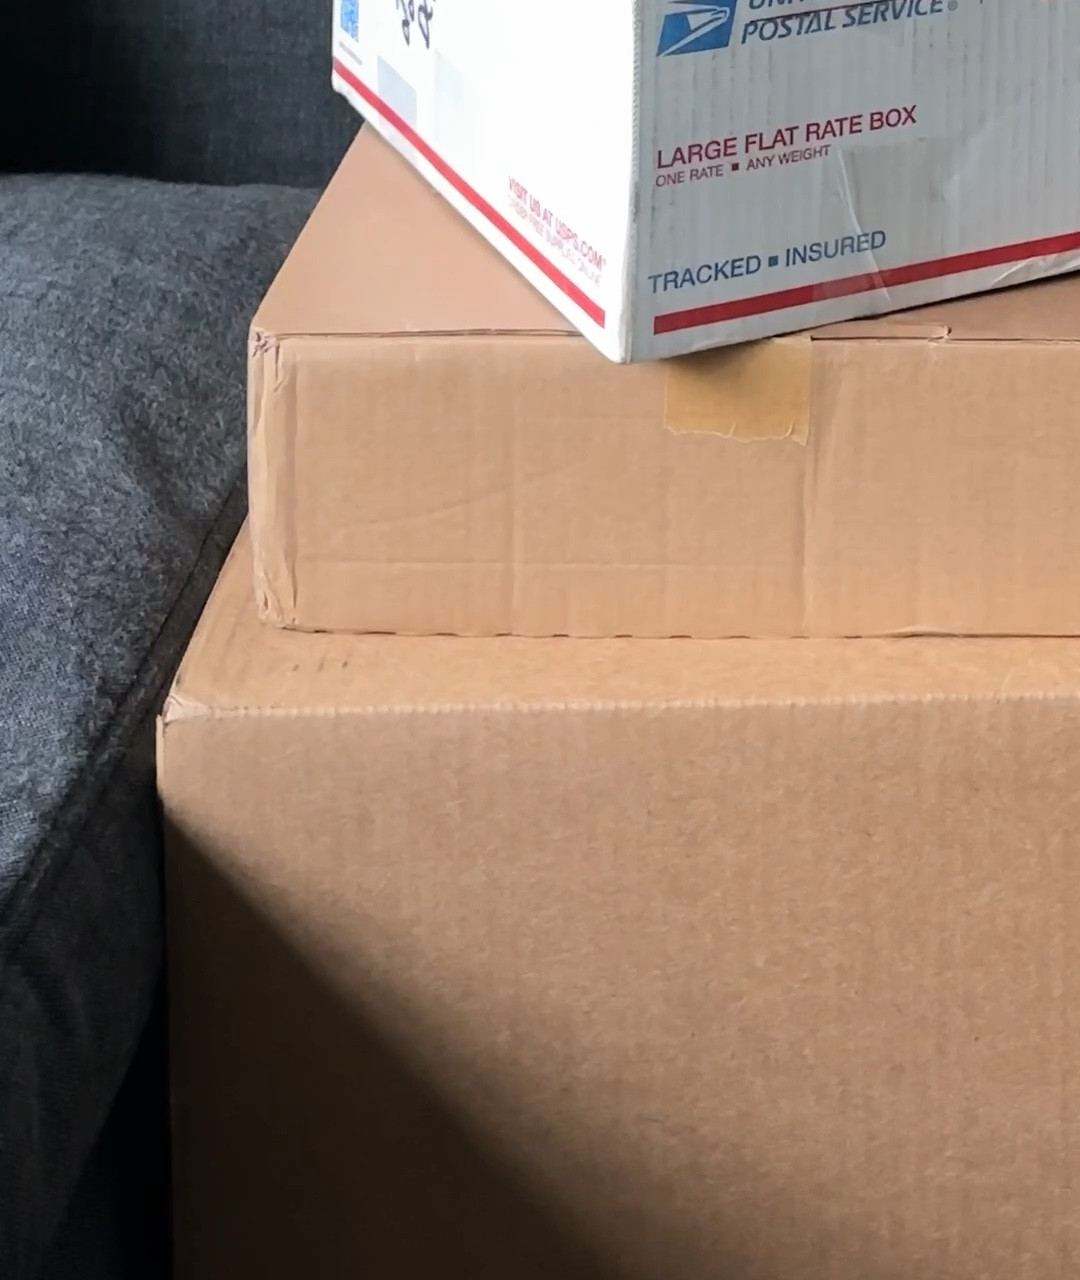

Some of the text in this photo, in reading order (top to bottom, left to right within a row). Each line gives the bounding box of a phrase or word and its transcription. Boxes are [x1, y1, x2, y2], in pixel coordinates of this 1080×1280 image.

[741, 10, 837, 45] POSTAL
[657, 104, 918, 169] LARGE FLAT RATE BOX
[655, 144, 832, 187] ONE RATE ANY WEIGHT
[647, 229, 887, 293] TRACKED INSURED
